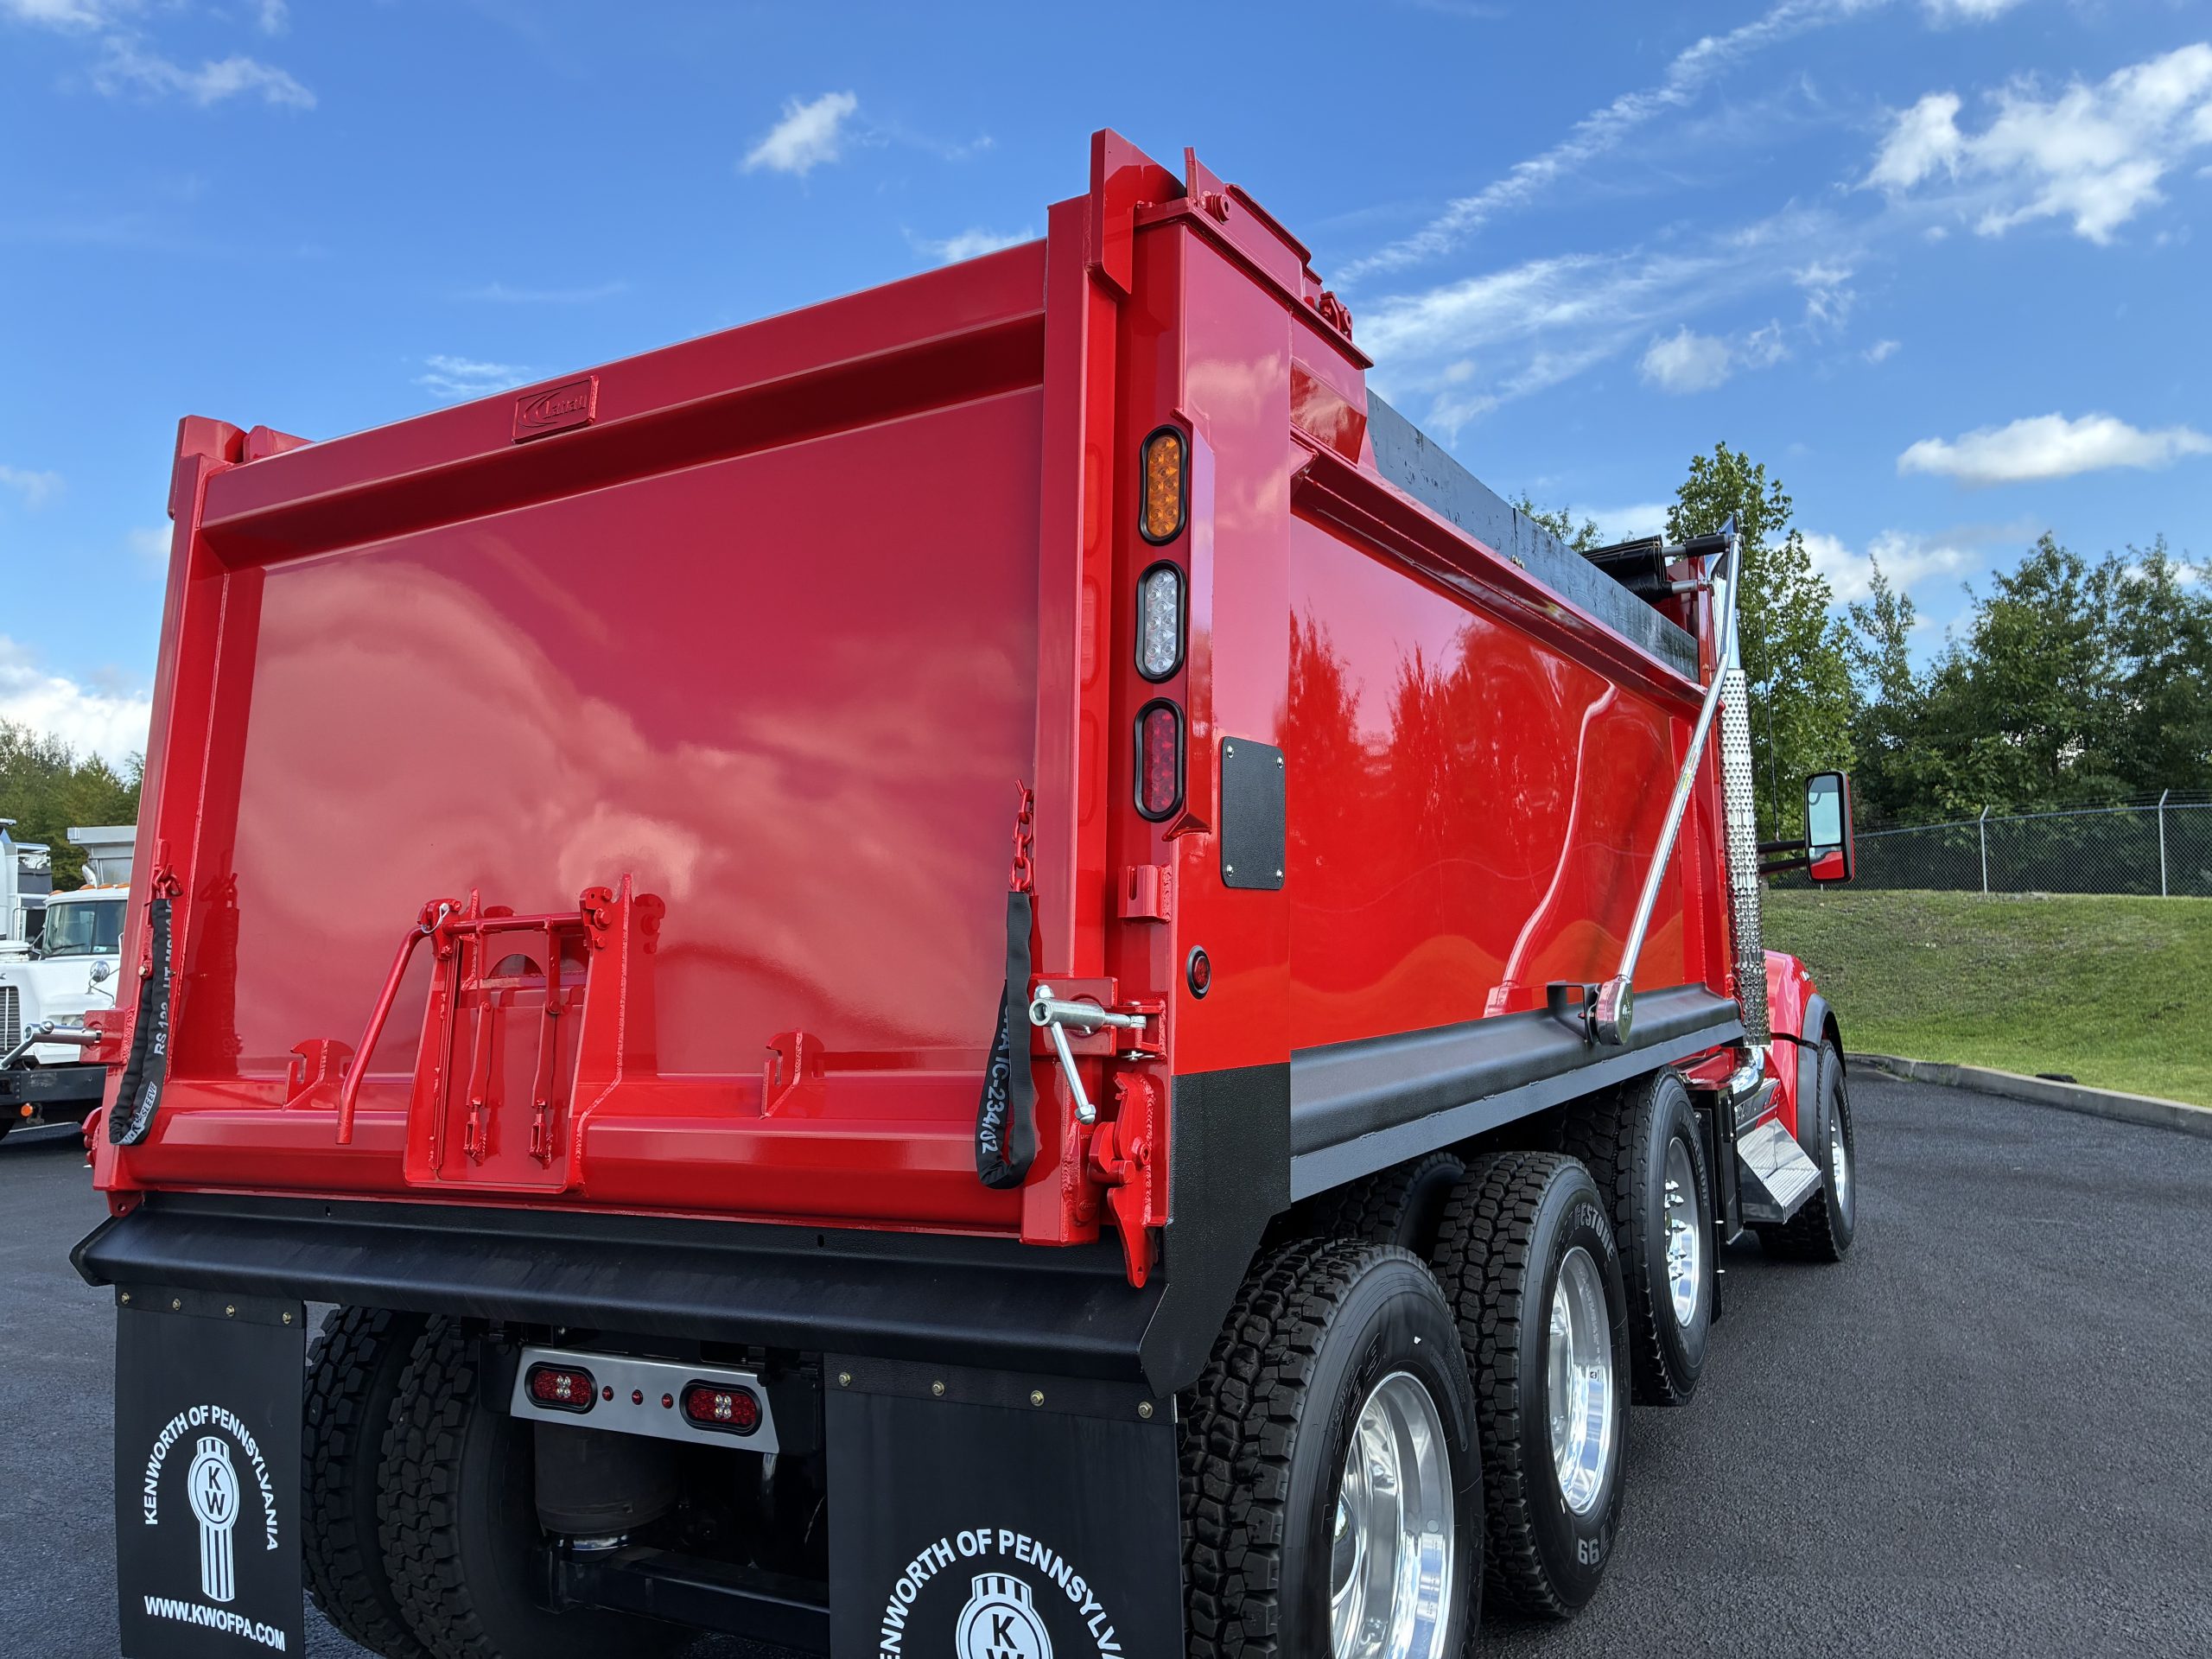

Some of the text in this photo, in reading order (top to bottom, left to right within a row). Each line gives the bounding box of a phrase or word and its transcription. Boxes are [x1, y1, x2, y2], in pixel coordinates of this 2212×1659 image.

[154, 1033, 167, 1056] RS
[142, 1082, 156, 1118] SLEEVE
[145, 1405, 278, 1550] KENWORTH OF PENNSYLVANIA
[880, 1529, 1124, 1659] NWORTH OF PENNSYLV
[144, 1596, 286, 1652] WWW.KWOFPA.COM
